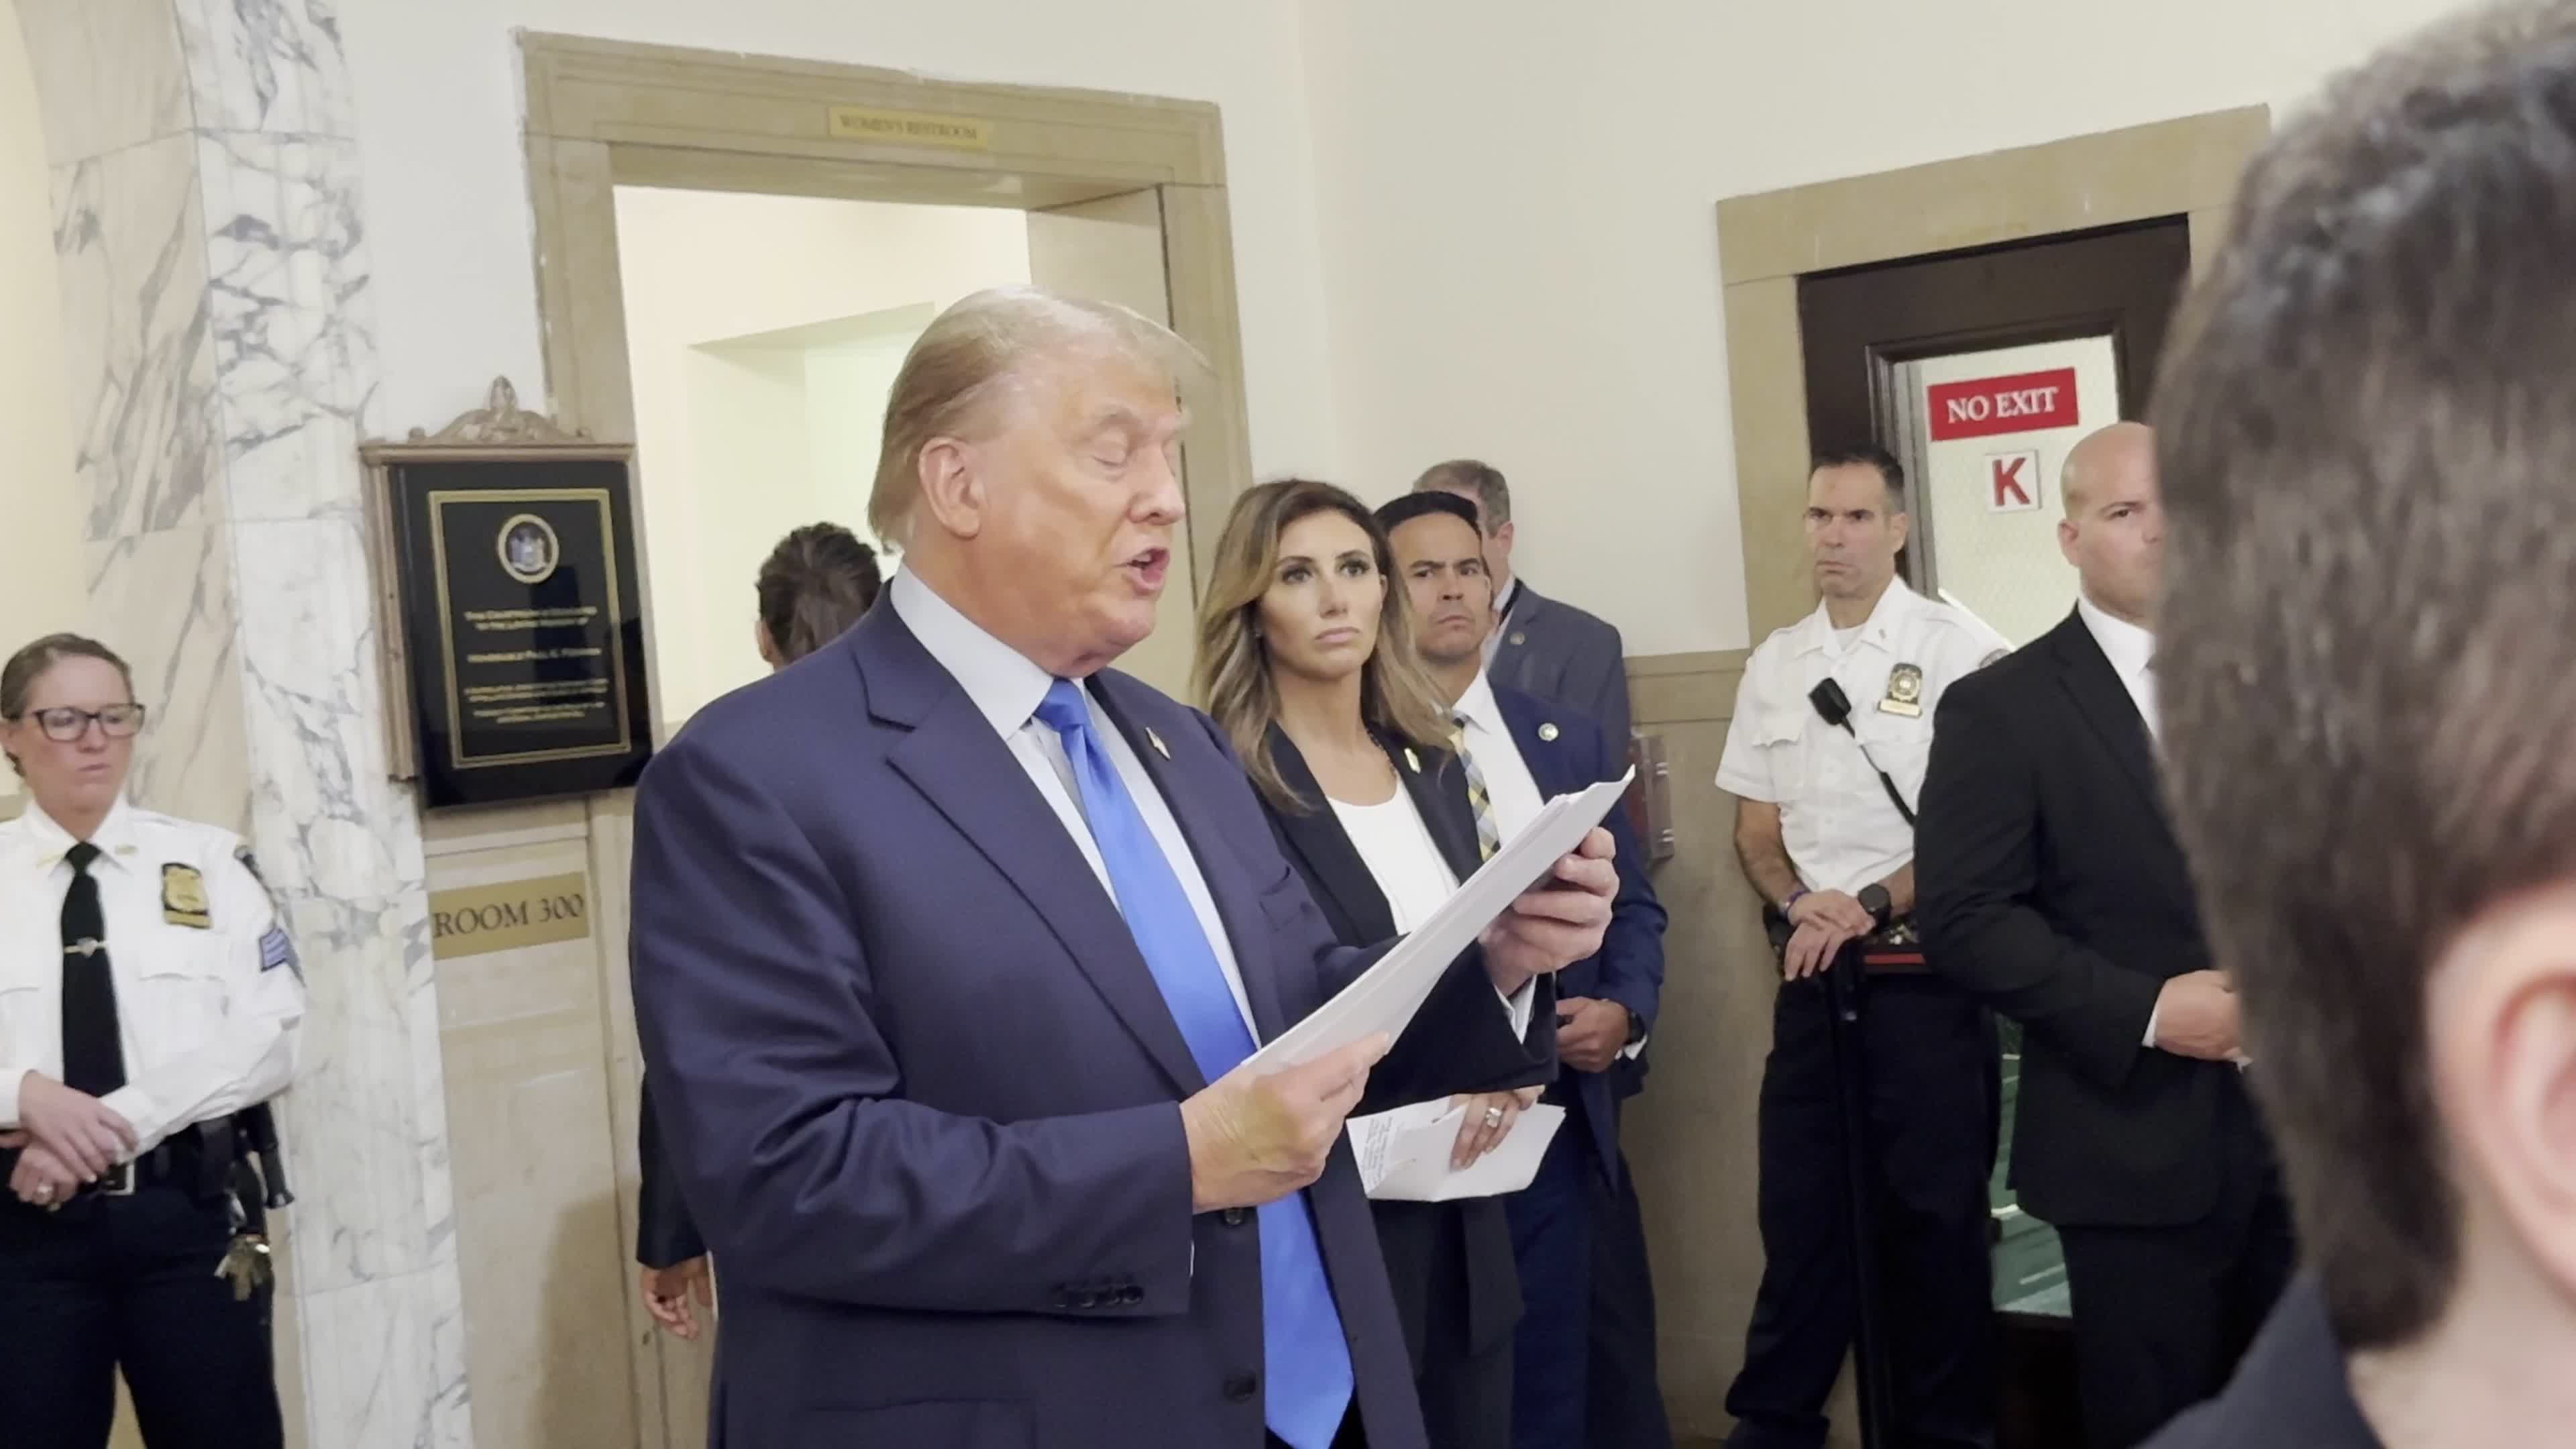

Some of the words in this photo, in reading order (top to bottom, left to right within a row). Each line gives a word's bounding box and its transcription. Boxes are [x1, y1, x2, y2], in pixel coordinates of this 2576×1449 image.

[1947, 395, 1990, 424] NO
[1994, 386, 2059, 418] EXIT
[1992, 457, 2031, 507] K
[433, 900, 529, 938] ROOM
[538, 893, 584, 922] 300
